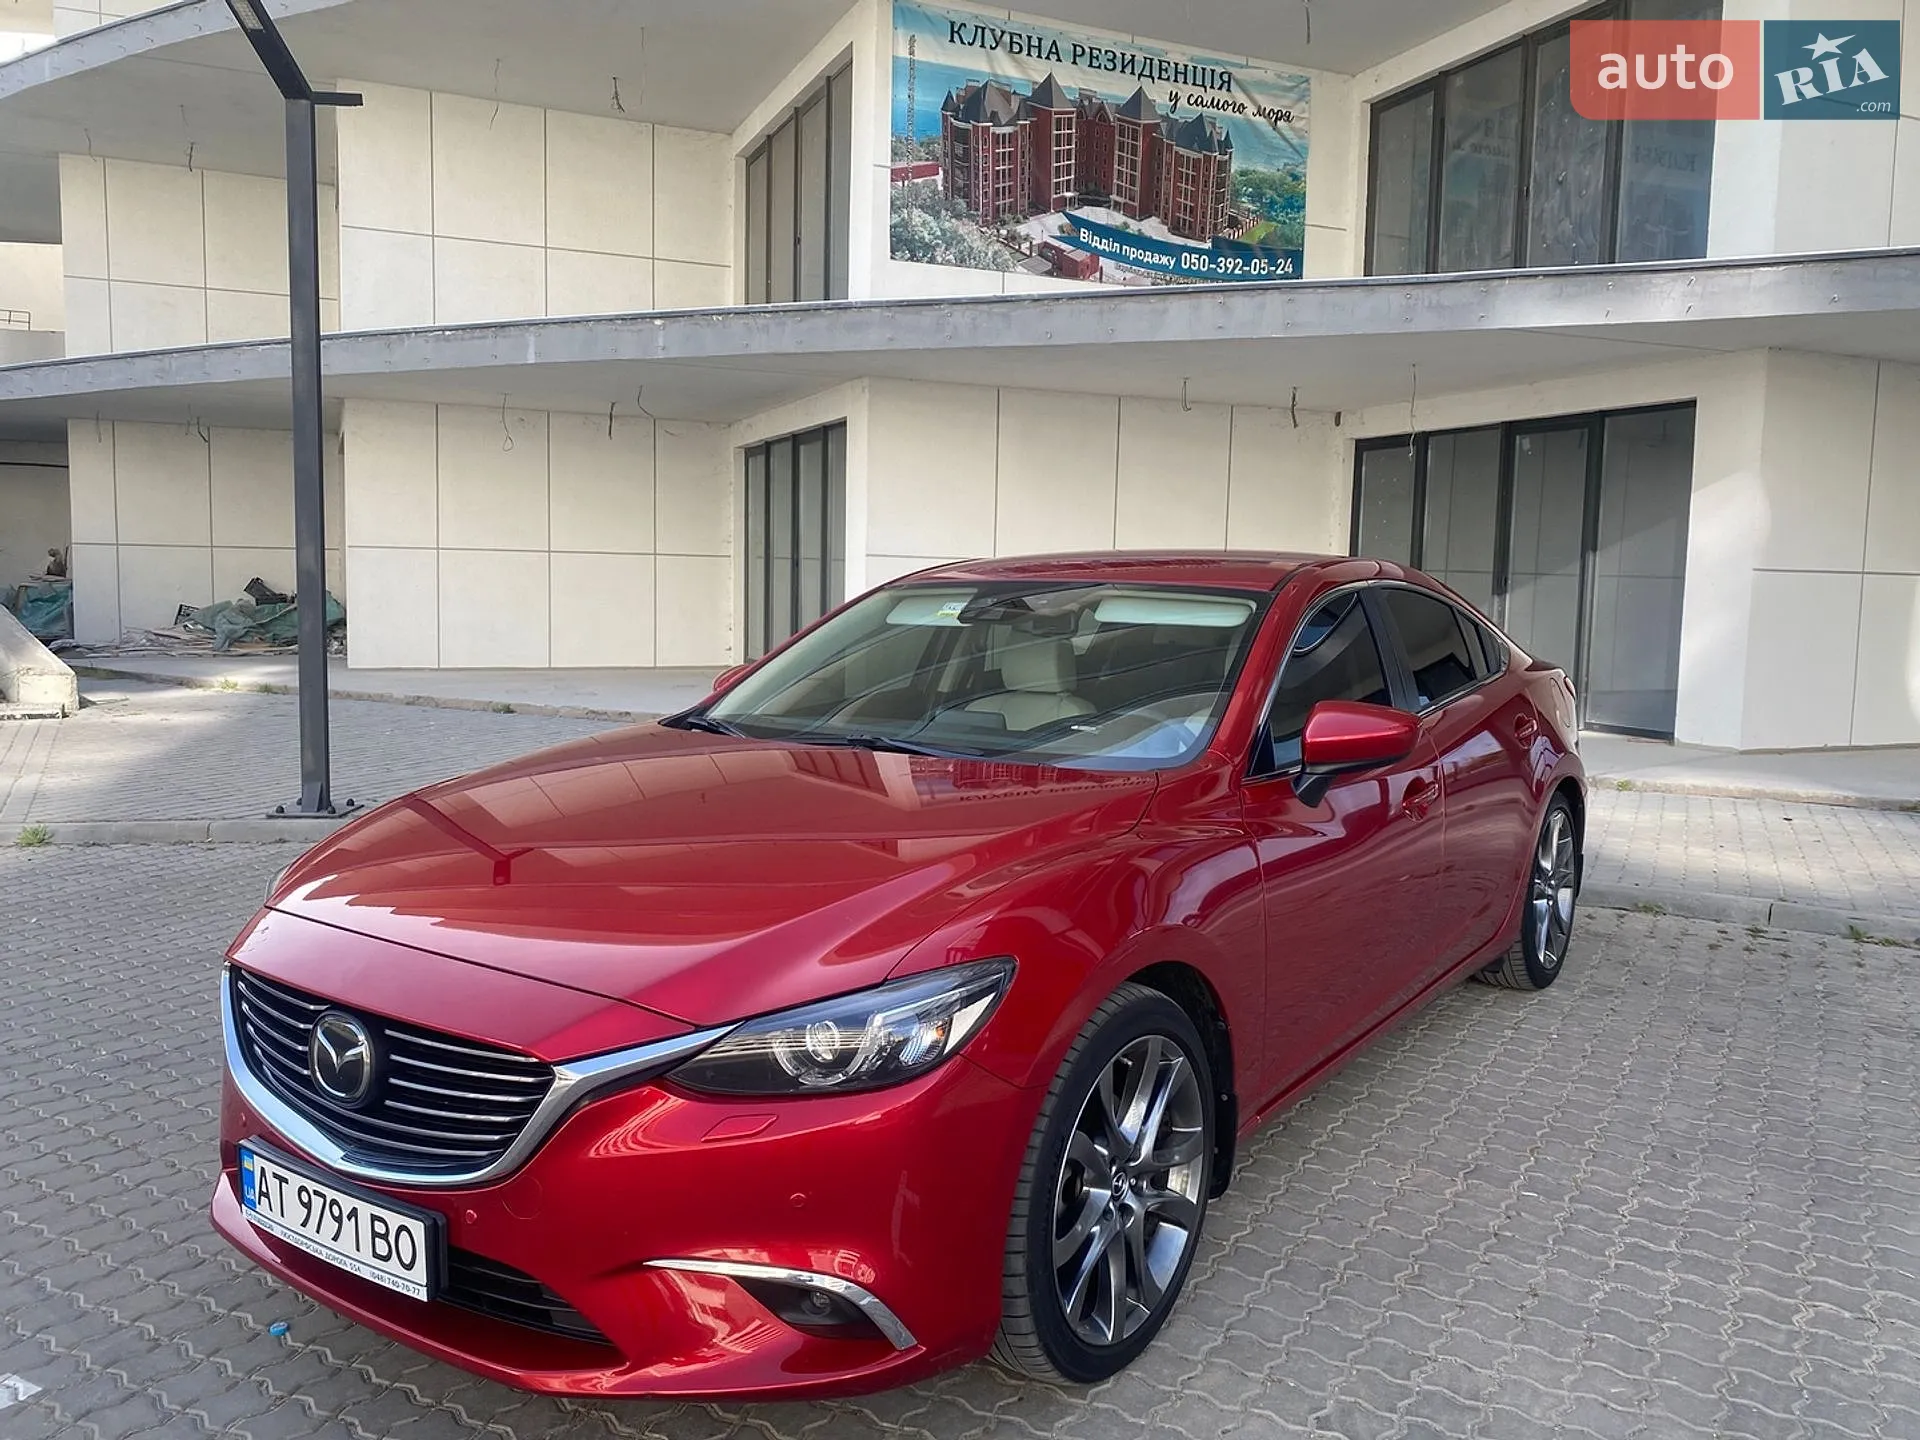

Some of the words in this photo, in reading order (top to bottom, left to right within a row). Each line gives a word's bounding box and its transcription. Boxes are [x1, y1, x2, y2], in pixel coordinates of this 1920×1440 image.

[947, 20, 1063, 63] КЛУБНА
[1071, 43, 1233, 93] РЕЗИДЕНЦІЯ
[1168, 90, 1181, 114] у
[1186, 93, 1247, 115] самого
[1252, 104, 1295, 126] моря
[1079, 228, 1120, 254] Відділ
[1122, 244, 1178, 269] продажу
[1180, 252, 1294, 275] 050-392-05-24
[243, 1184, 256, 1201] UA
[257, 1166, 289, 1218] AT
[297, 1185, 361, 1253] 9791
[370, 1213, 417, 1272] BO
